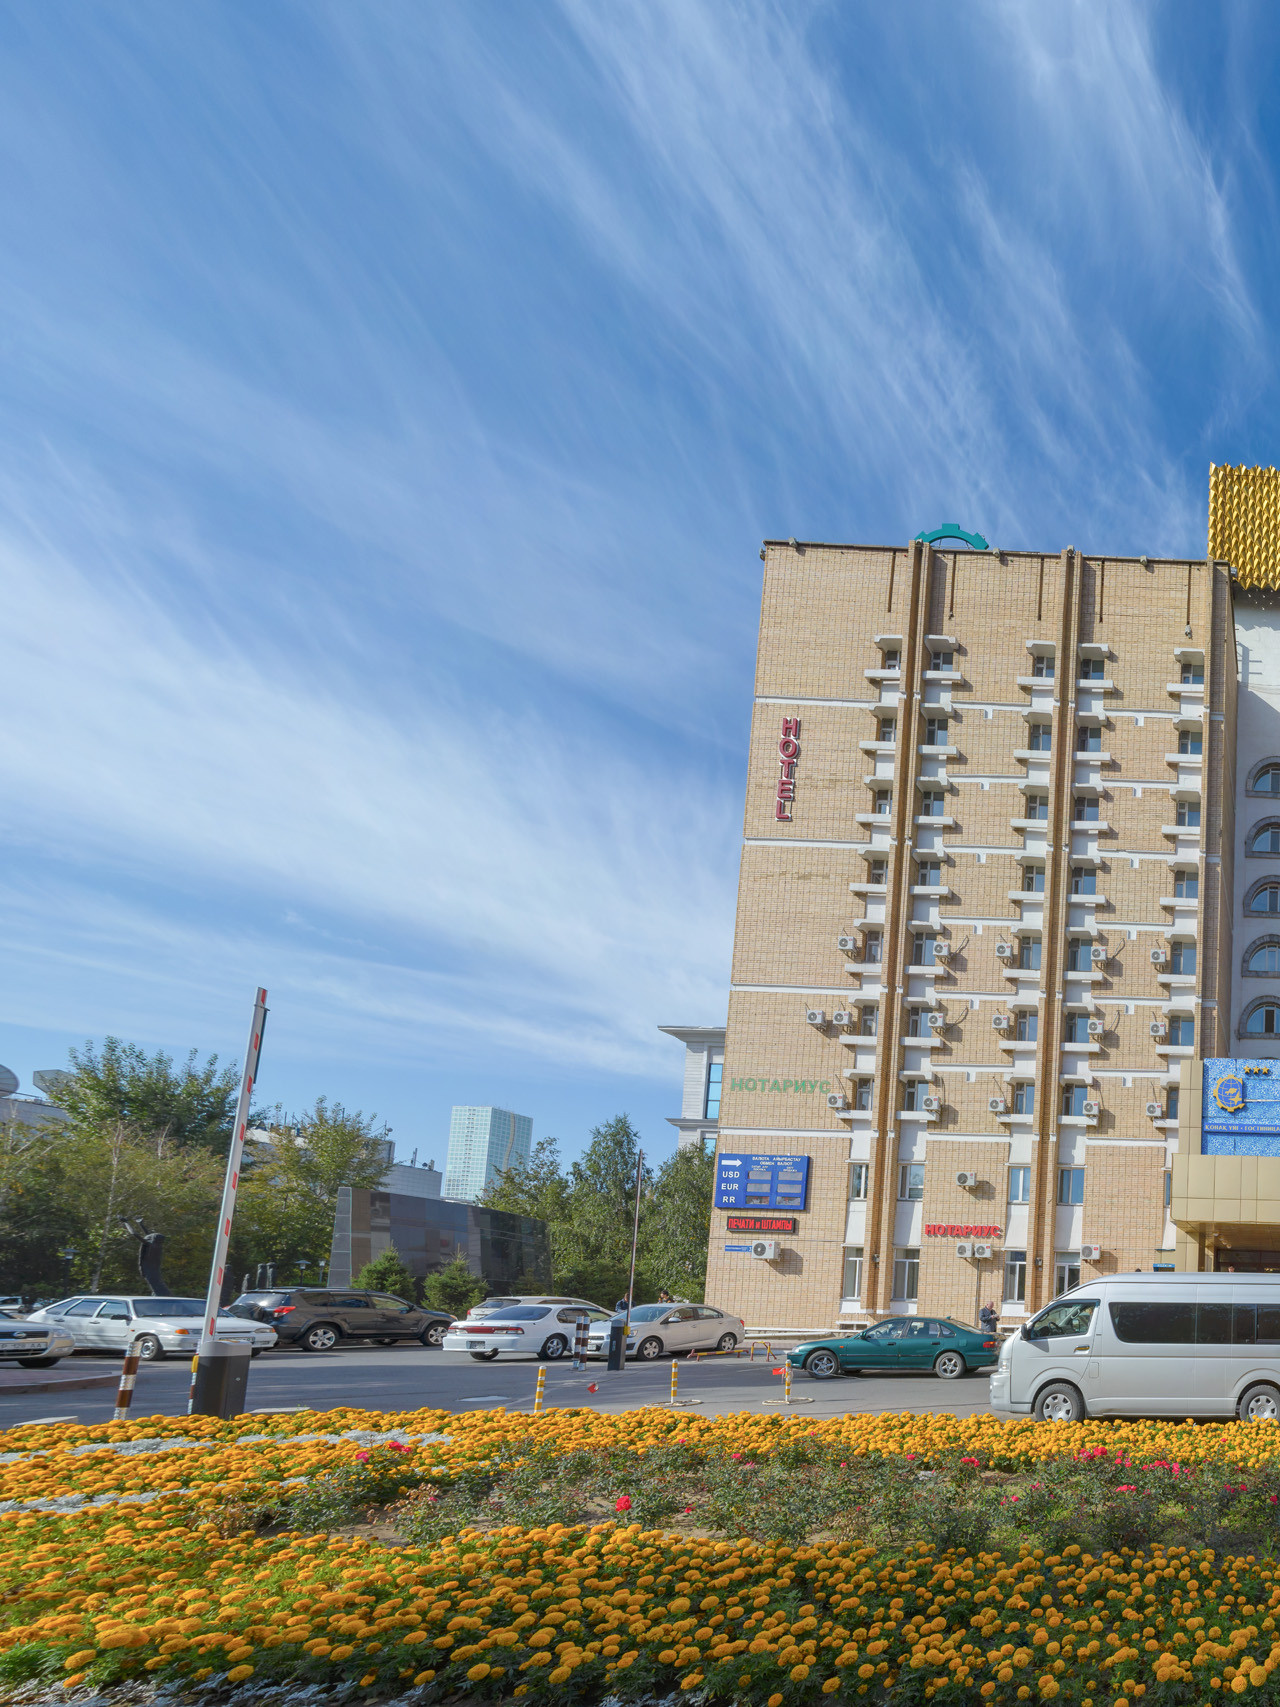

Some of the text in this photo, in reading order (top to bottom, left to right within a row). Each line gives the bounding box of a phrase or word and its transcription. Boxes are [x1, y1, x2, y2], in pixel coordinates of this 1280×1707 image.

[776, 717, 800, 821] HOTEL
[730, 1077, 831, 1094] НОТАРИУС
[728, 1218, 755, 1229] ПЕЧАТИ
[761, 1219, 793, 1230] ШТАМПЫ
[925, 1223, 1001, 1237] НОТАРИУС
